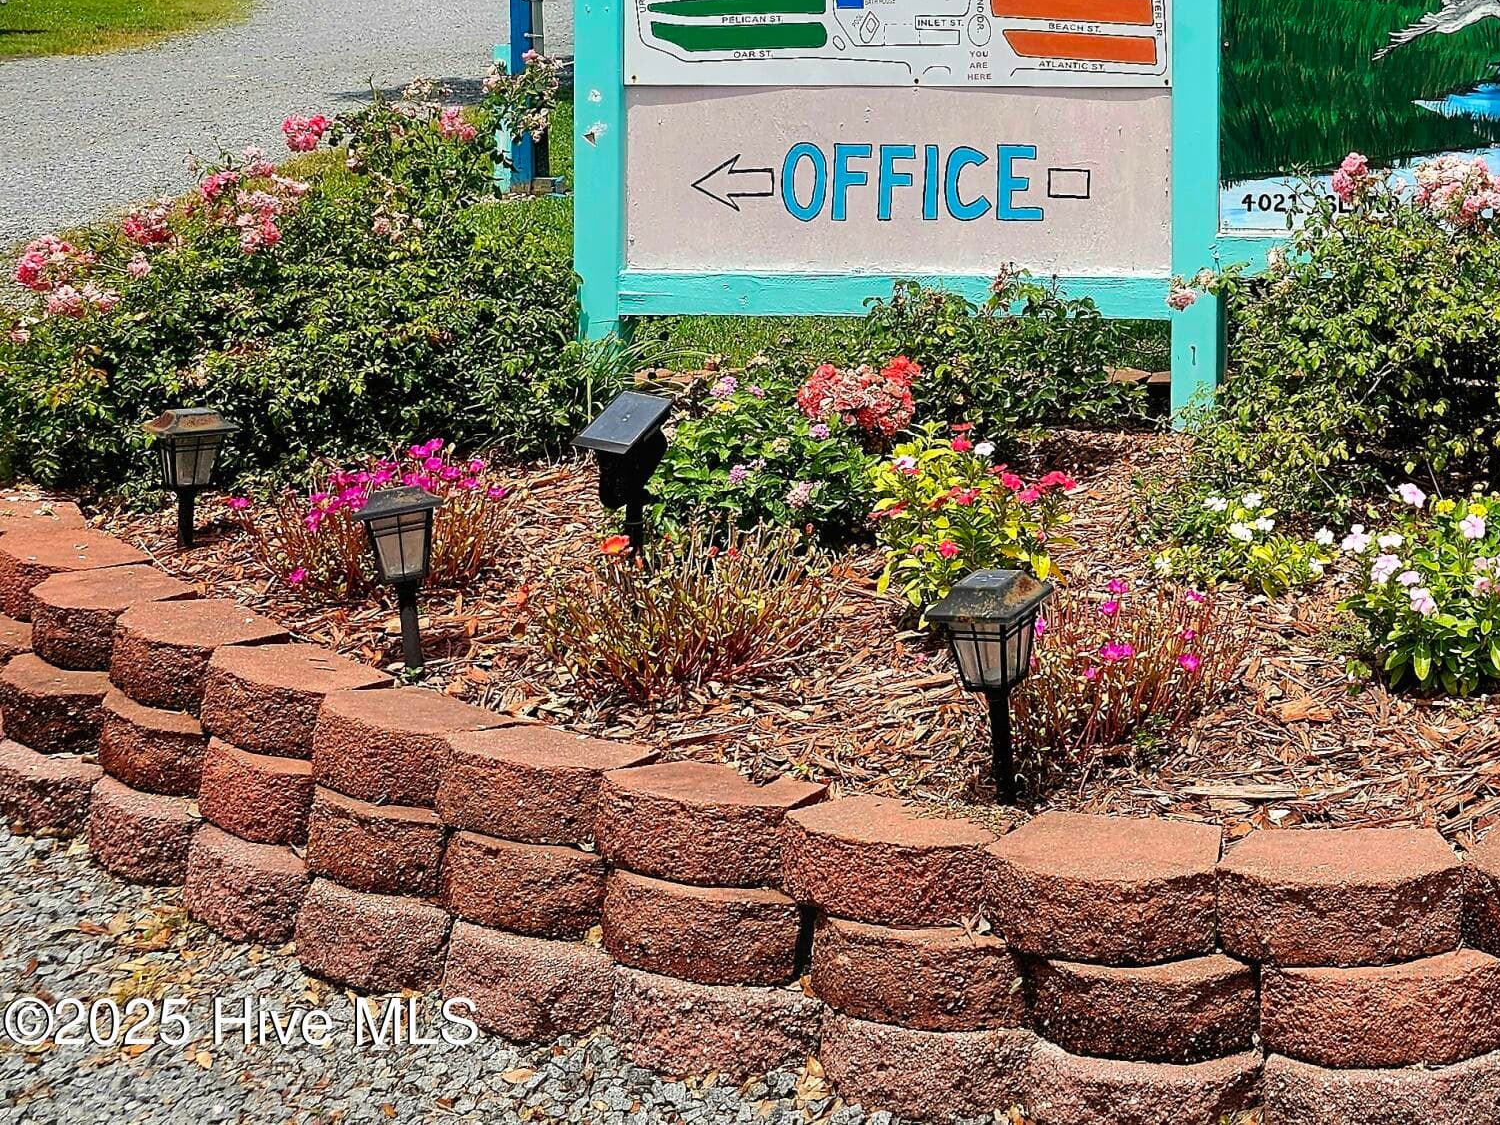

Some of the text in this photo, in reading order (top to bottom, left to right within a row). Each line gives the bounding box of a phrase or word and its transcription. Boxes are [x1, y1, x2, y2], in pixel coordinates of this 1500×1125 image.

[721, 15, 784, 24] PELICAN ST.
[917, 19, 965, 27] INLET ST.
[1048, 22, 1102, 33] BEACH ST.
[733, 50, 774, 59] OAR ST.
[969, 50, 989, 58] YOU
[1038, 60, 1106, 71] ATLANTIC ST.
[967, 73, 992, 81] HERE
[781, 142, 1044, 222] OFFICE
